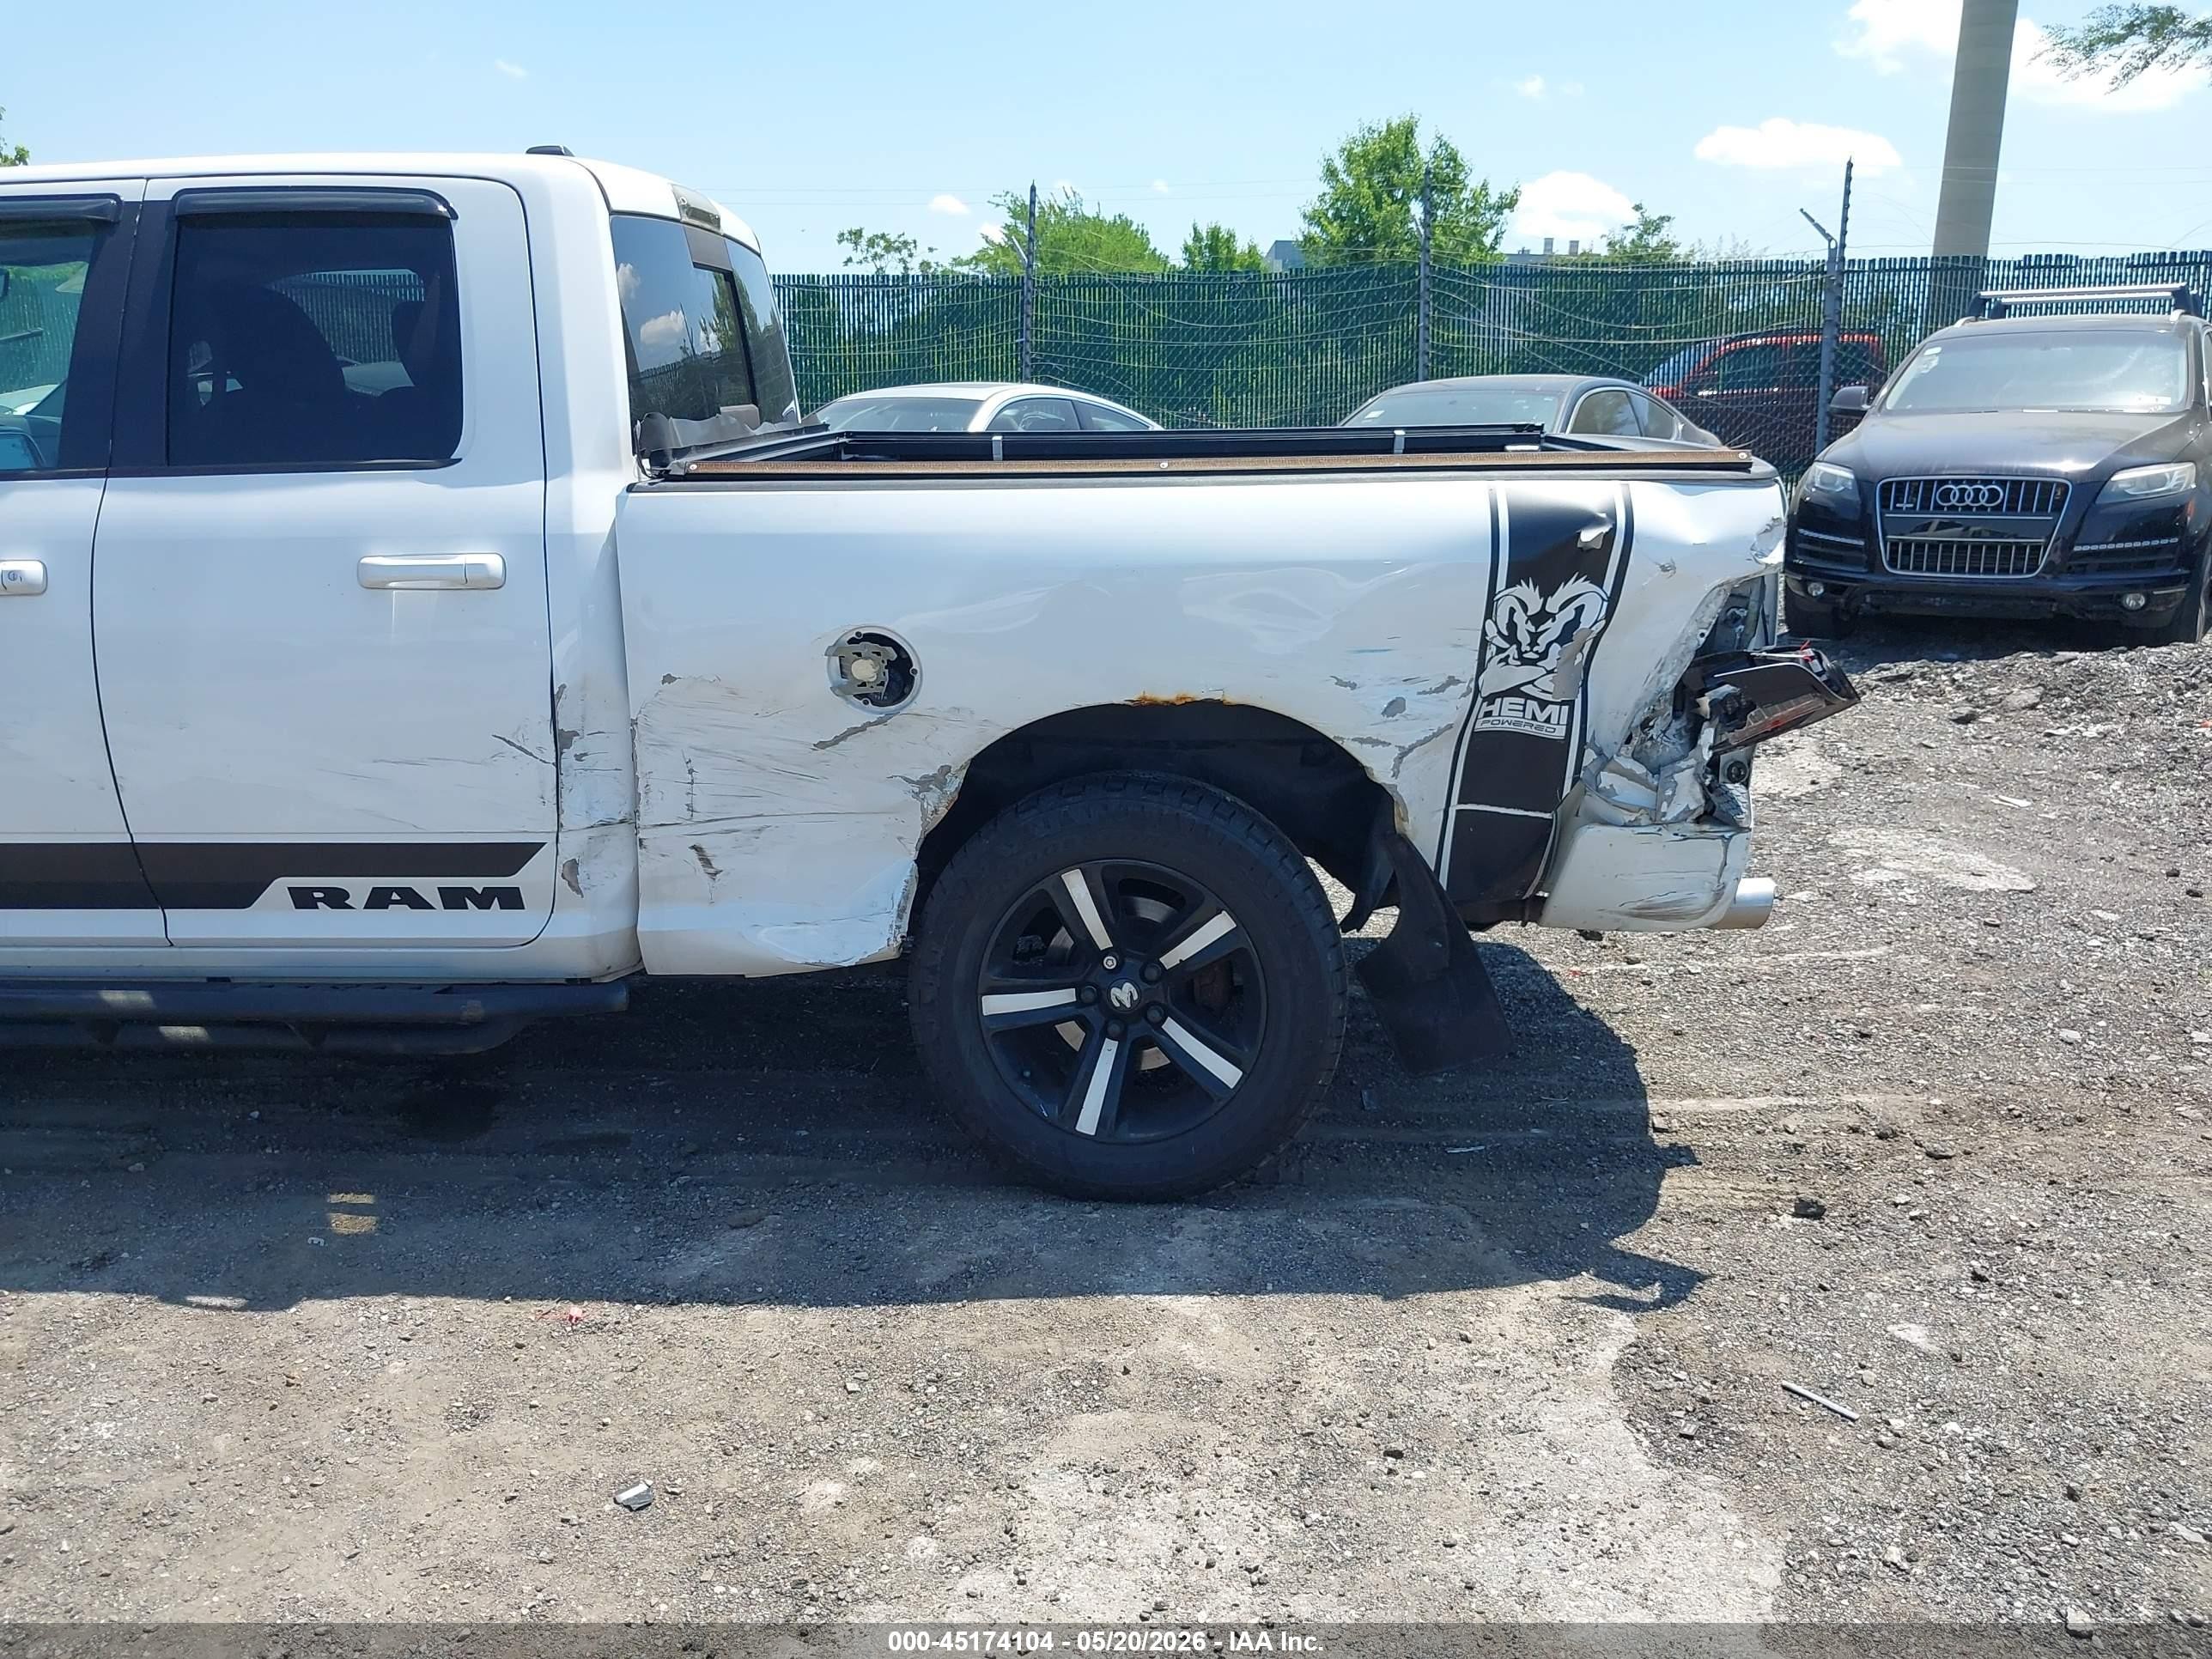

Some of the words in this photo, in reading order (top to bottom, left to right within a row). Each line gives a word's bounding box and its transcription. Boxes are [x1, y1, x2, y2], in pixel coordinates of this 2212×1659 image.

[1478, 697, 1570, 725] HEMI
[1480, 719, 1557, 733] POWERED
[287, 886, 526, 910] RAM
